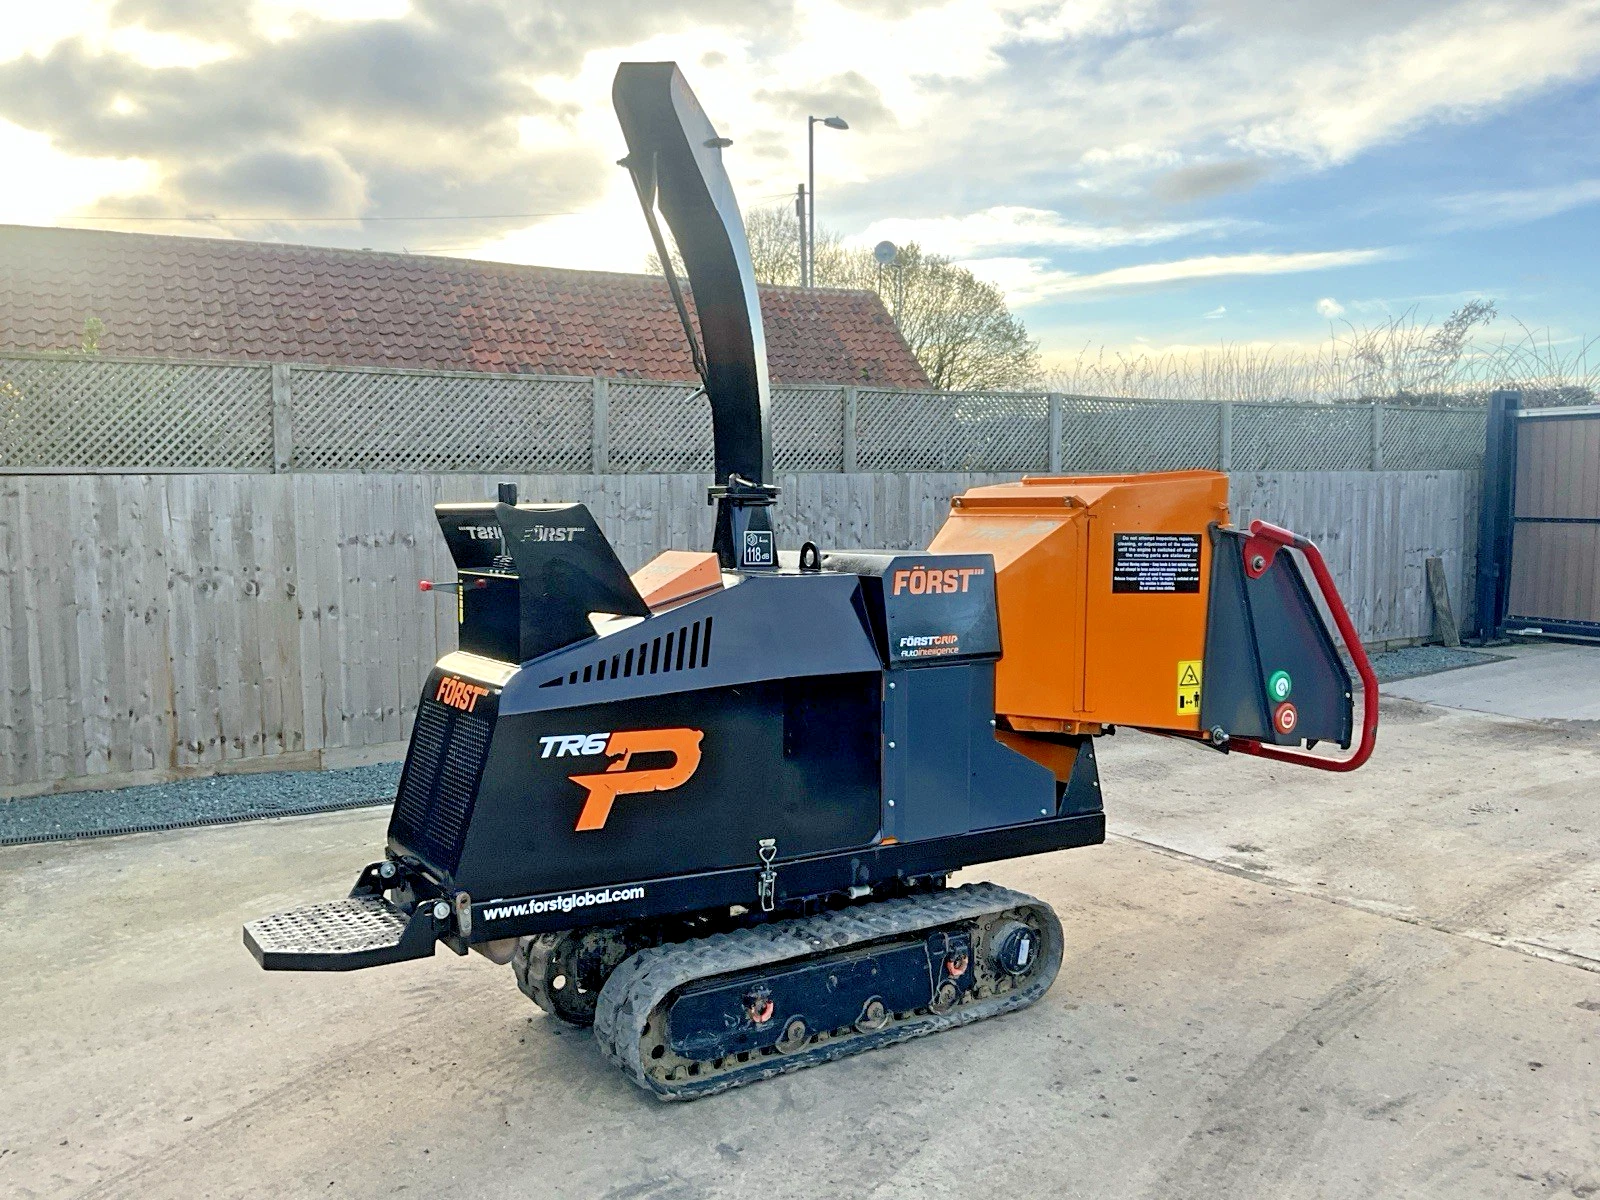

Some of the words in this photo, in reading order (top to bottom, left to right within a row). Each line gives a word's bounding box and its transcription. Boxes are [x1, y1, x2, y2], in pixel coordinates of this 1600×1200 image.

[746, 547, 761, 562] 118
[894, 566, 984, 595] FÖRST
[436, 675, 490, 713] FÖRST
[539, 732, 611, 759] TR6
[483, 887, 645, 921] www.forstglobal.com
